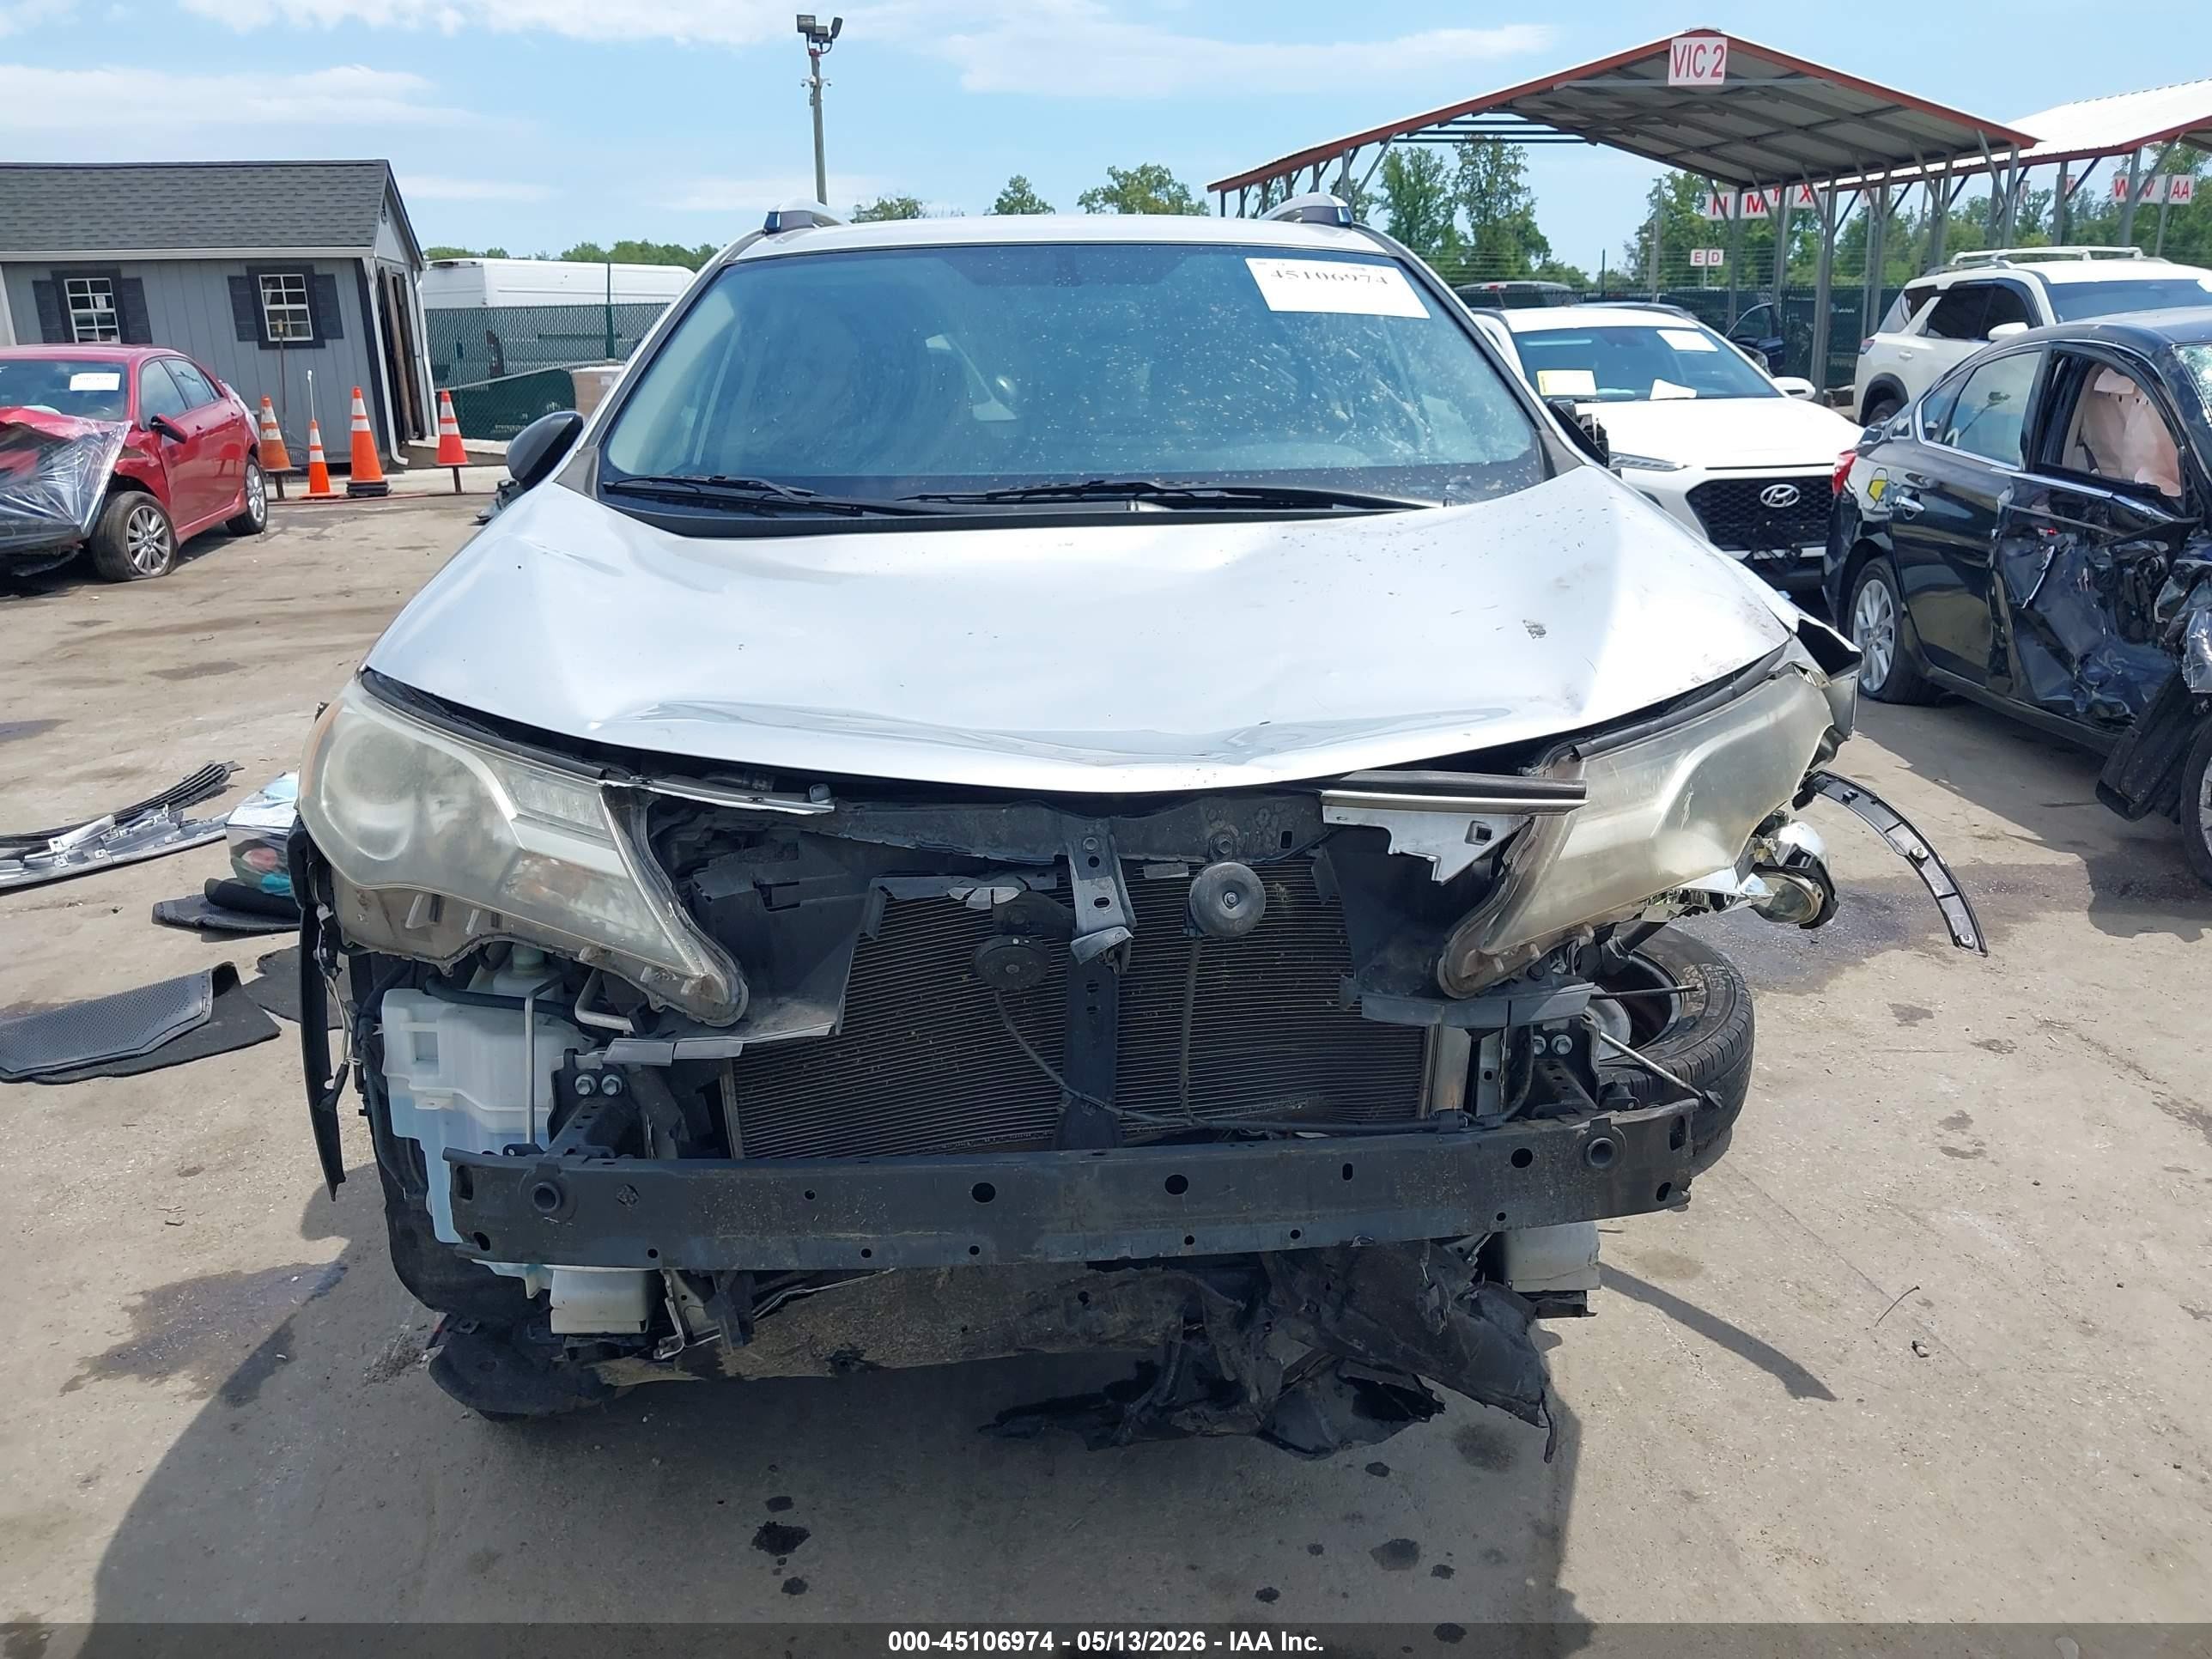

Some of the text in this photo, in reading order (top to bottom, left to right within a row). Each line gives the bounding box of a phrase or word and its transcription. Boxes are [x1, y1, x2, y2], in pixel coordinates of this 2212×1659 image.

[1673, 43, 1725, 78] VIC 2
[1799, 182, 1813, 203] X
[2171, 180, 2189, 199] AA
[1712, 196, 1728, 216] N
[1746, 194, 1765, 213] M
[1694, 252, 1703, 263] E
[1711, 252, 1720, 263] D
